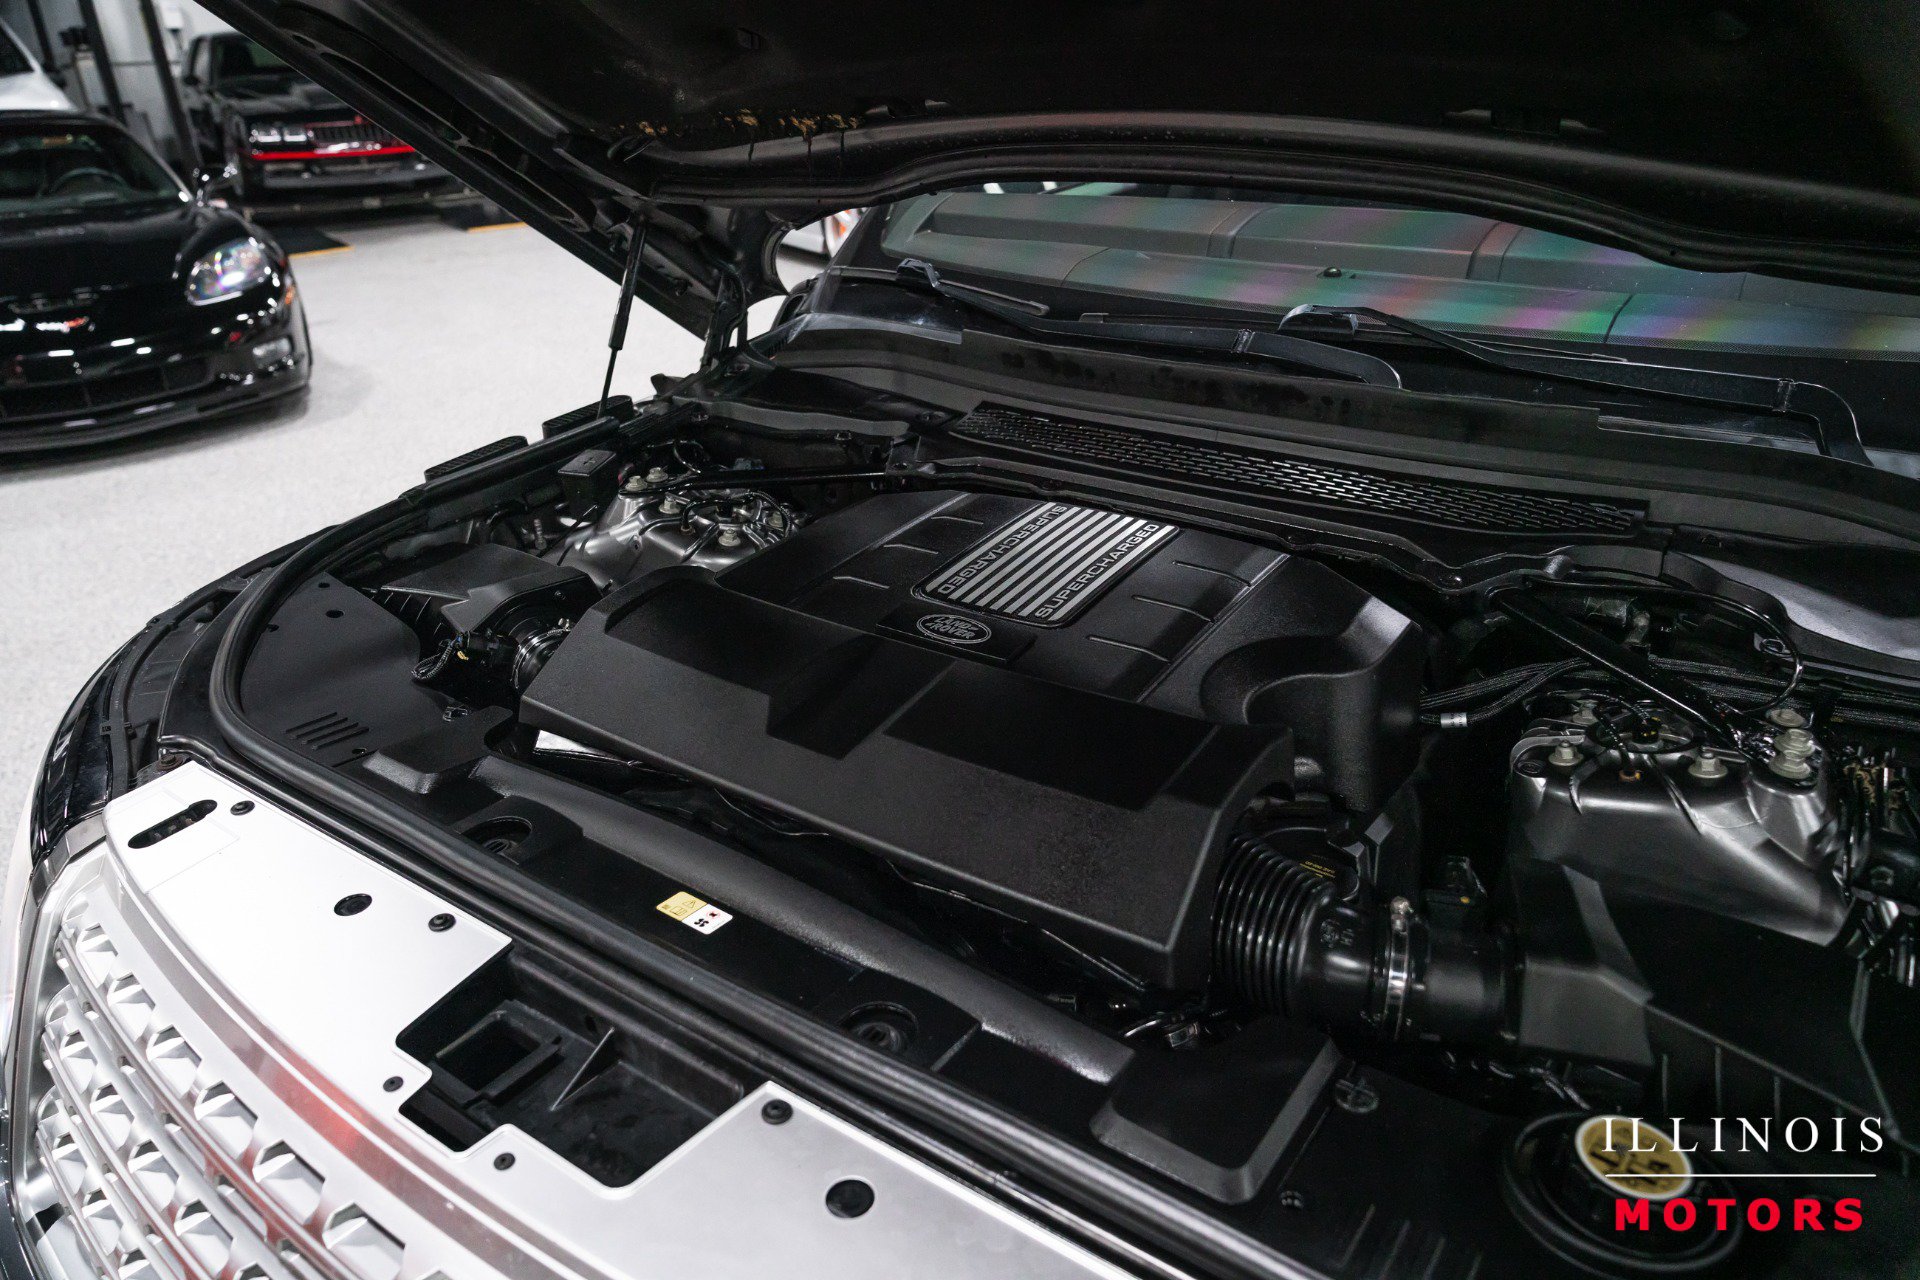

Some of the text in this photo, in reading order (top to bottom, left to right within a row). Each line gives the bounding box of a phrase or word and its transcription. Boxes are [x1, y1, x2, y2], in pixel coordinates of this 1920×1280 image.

[937, 505, 1068, 595] SUPERCHARGED
[1034, 524, 1160, 619] SUPERCHARGED
[930, 622, 977, 640] ROVER
[933, 616, 972, 630] LAND
